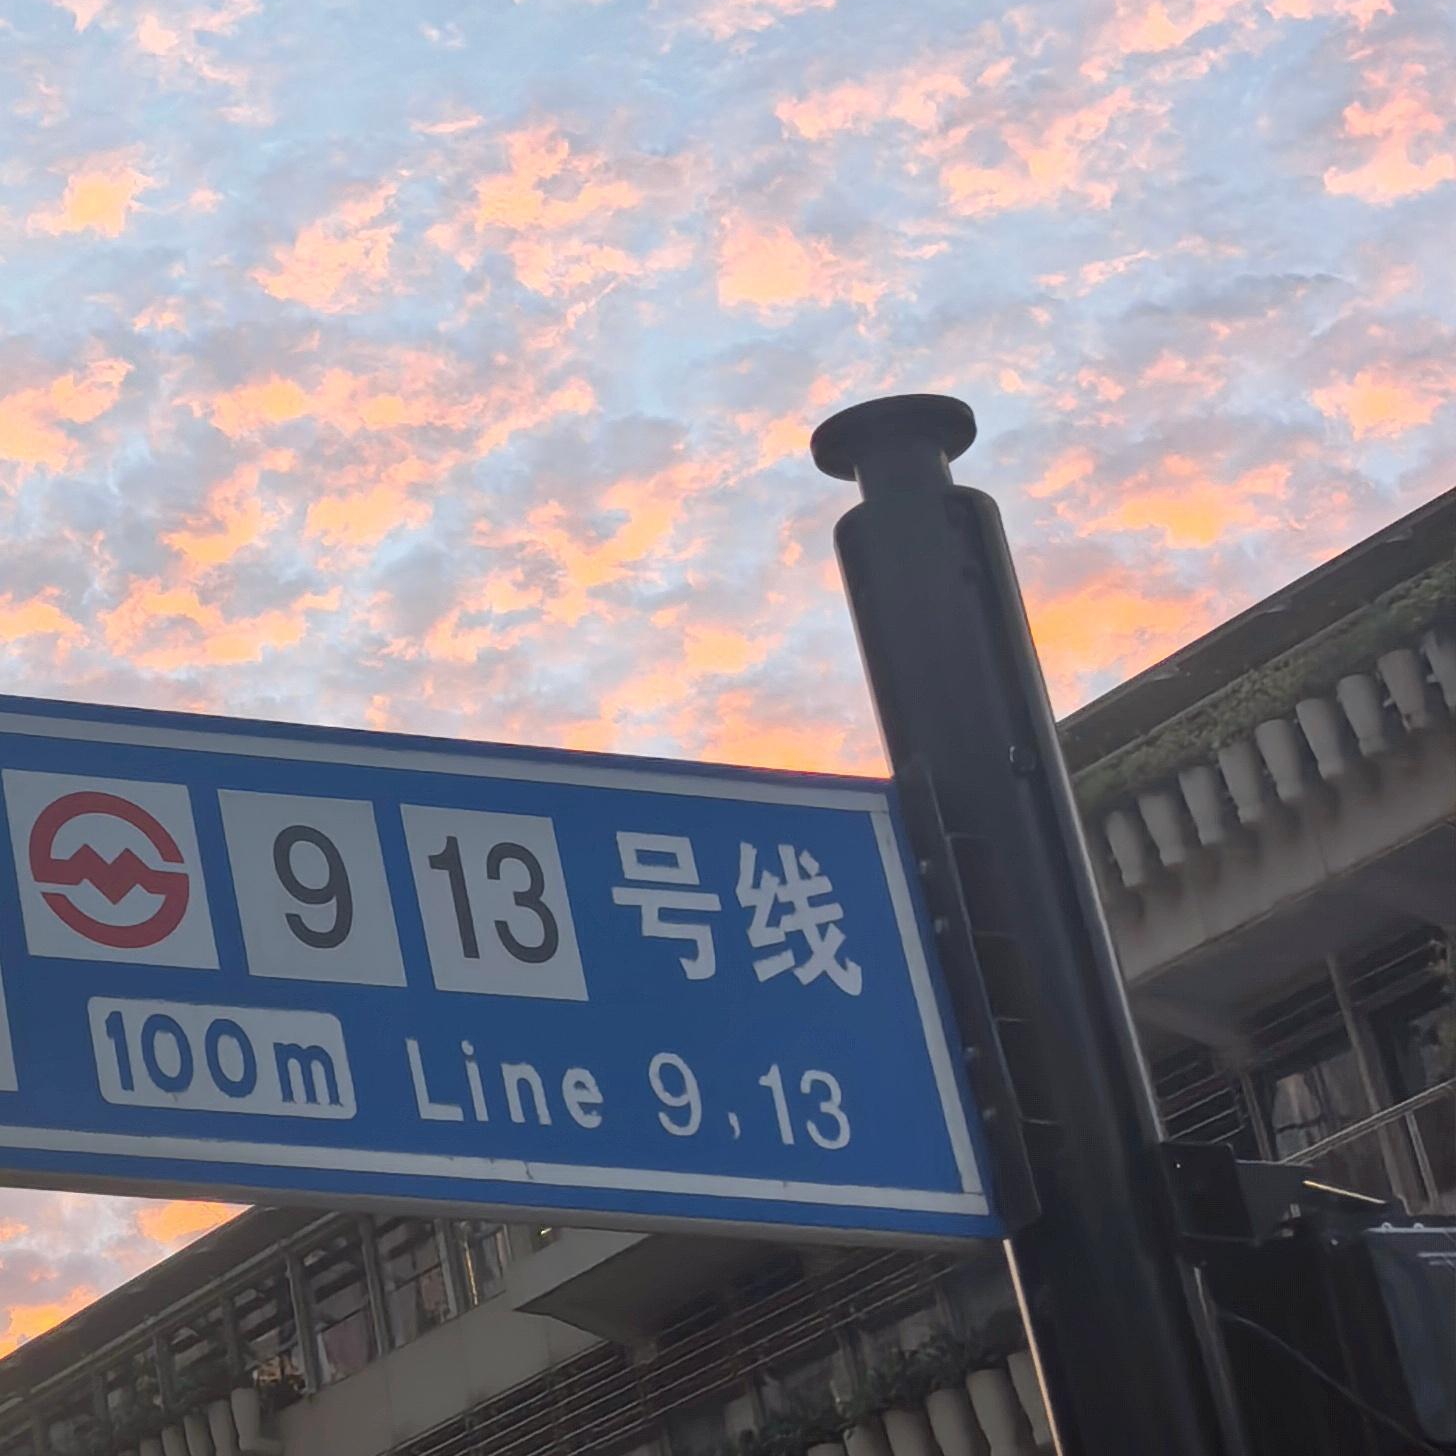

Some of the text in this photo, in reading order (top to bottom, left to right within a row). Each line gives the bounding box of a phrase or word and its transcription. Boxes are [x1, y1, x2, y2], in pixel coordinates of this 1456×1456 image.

[272, 824, 863, 996] 9 13 号线
[104, 1010, 343, 1107] 100m
[405, 1038, 604, 1129] Line
